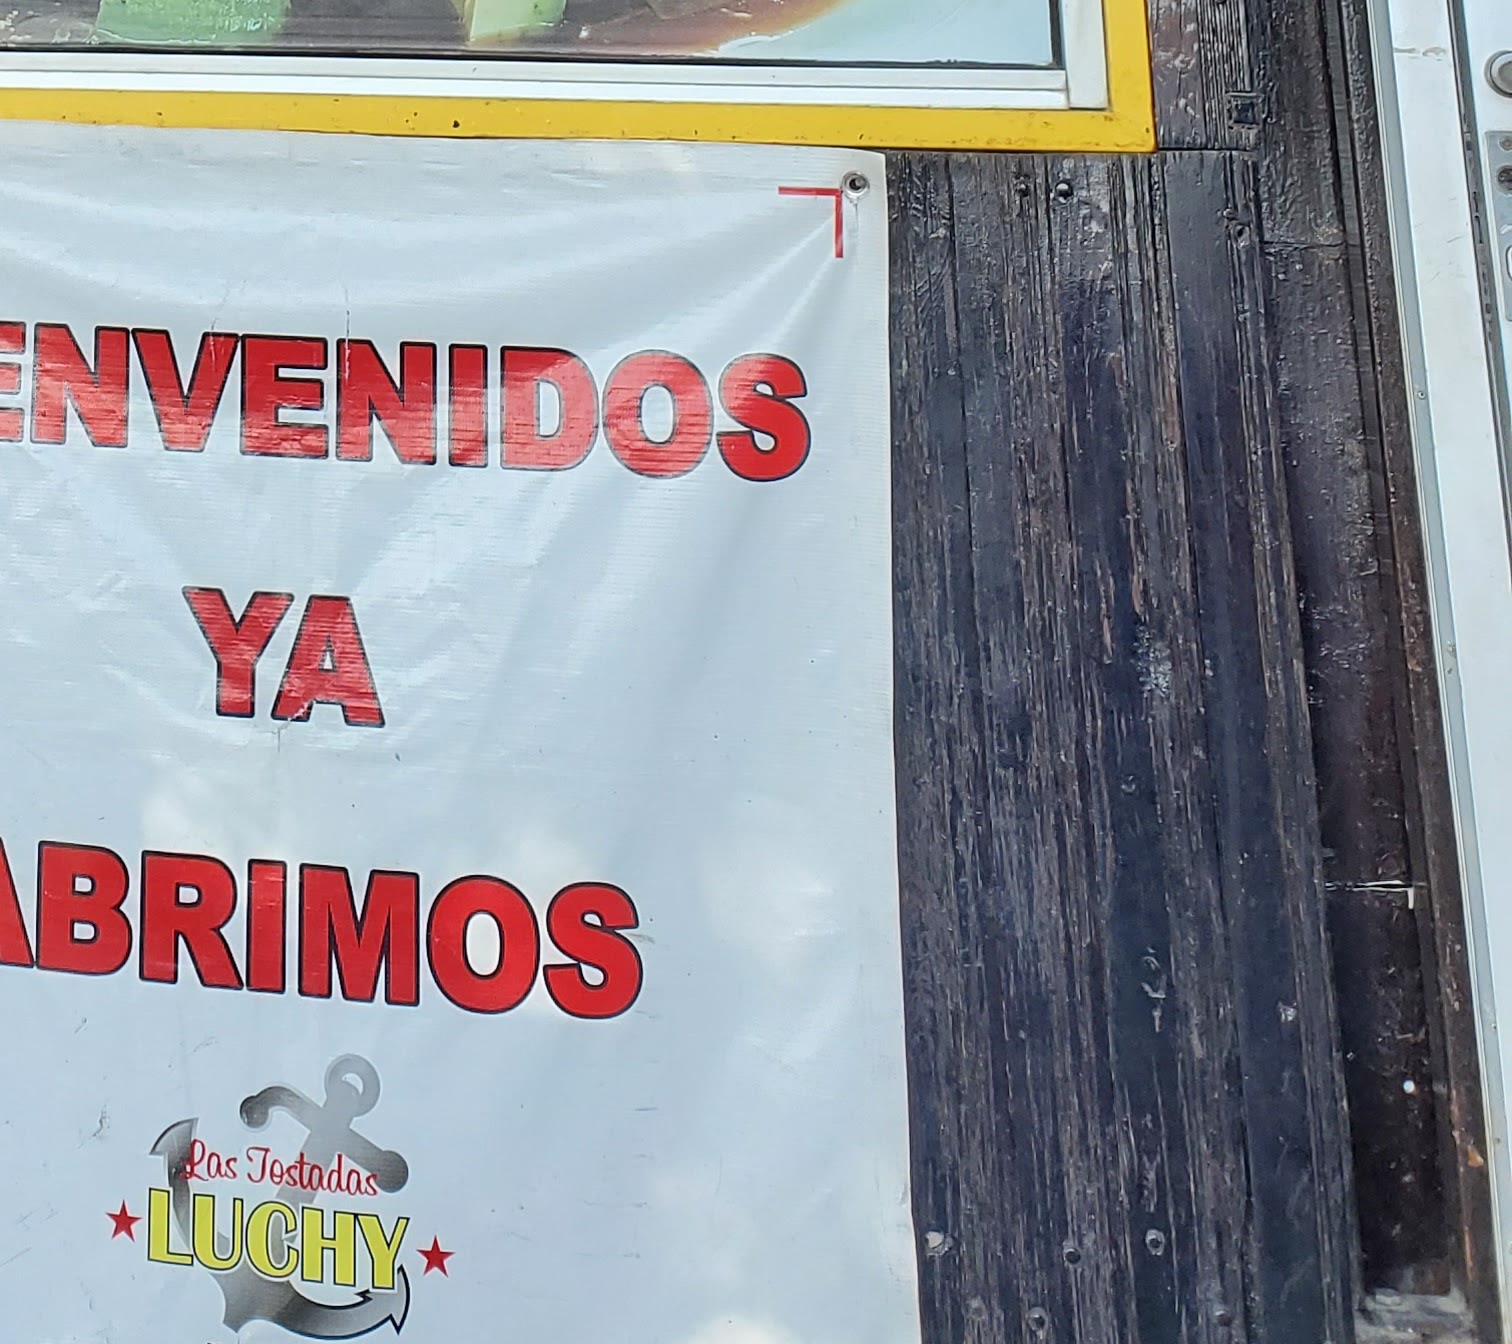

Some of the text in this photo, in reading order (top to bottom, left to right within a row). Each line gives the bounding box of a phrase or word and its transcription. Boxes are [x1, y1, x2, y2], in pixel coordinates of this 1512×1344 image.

[181, 586, 388, 729] YA
[181, 1138, 380, 1197] Las Tostadas
[147, 1187, 410, 1291] LUCHY
